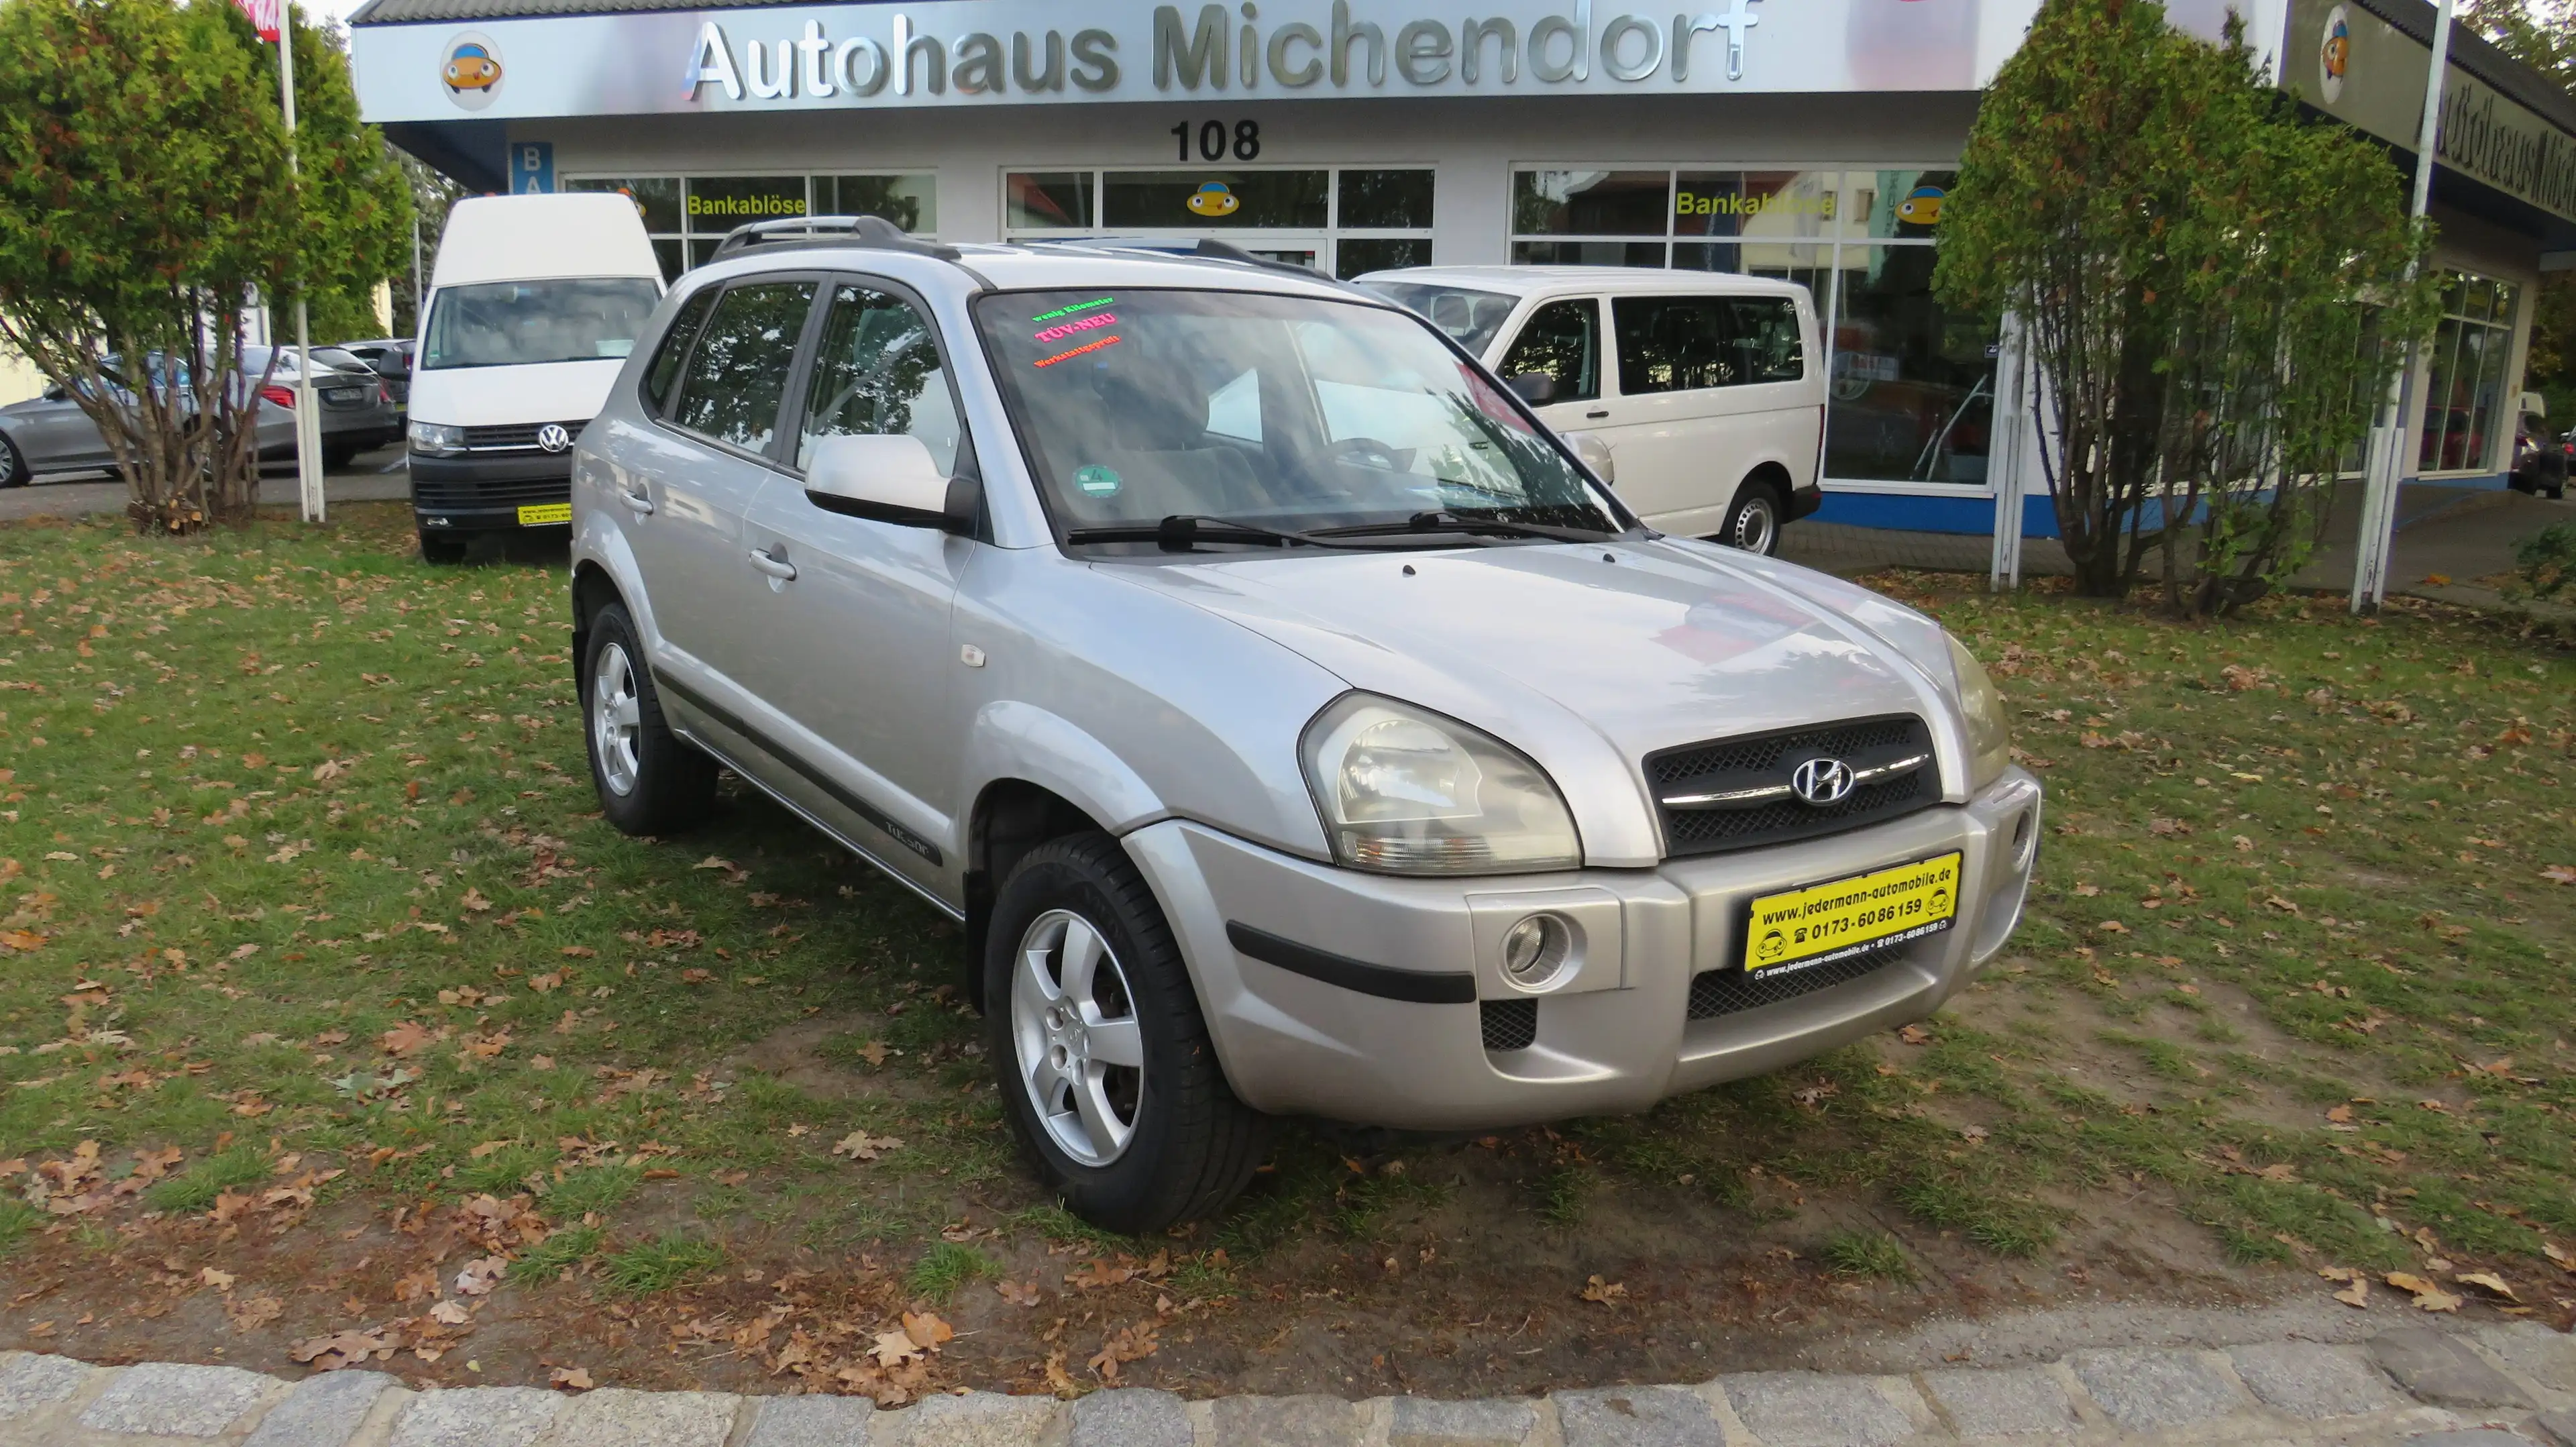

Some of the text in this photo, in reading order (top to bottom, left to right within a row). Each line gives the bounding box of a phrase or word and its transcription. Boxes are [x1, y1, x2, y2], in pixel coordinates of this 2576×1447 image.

[681, 0, 1760, 101] Autohaus Michendorf
[1171, 119, 1260, 162] 108
[2414, 82, 2534, 194] utohaus
[687, 195, 806, 215] Bankablöse
[1032, 309, 1066, 322] wenig
[1034, 313, 1118, 343] TÜV-NEU
[1762, 867, 1951, 926] www.jedermann-automobile.de
[1766, 943, 1870, 977] www.jedermann-automobile.de
